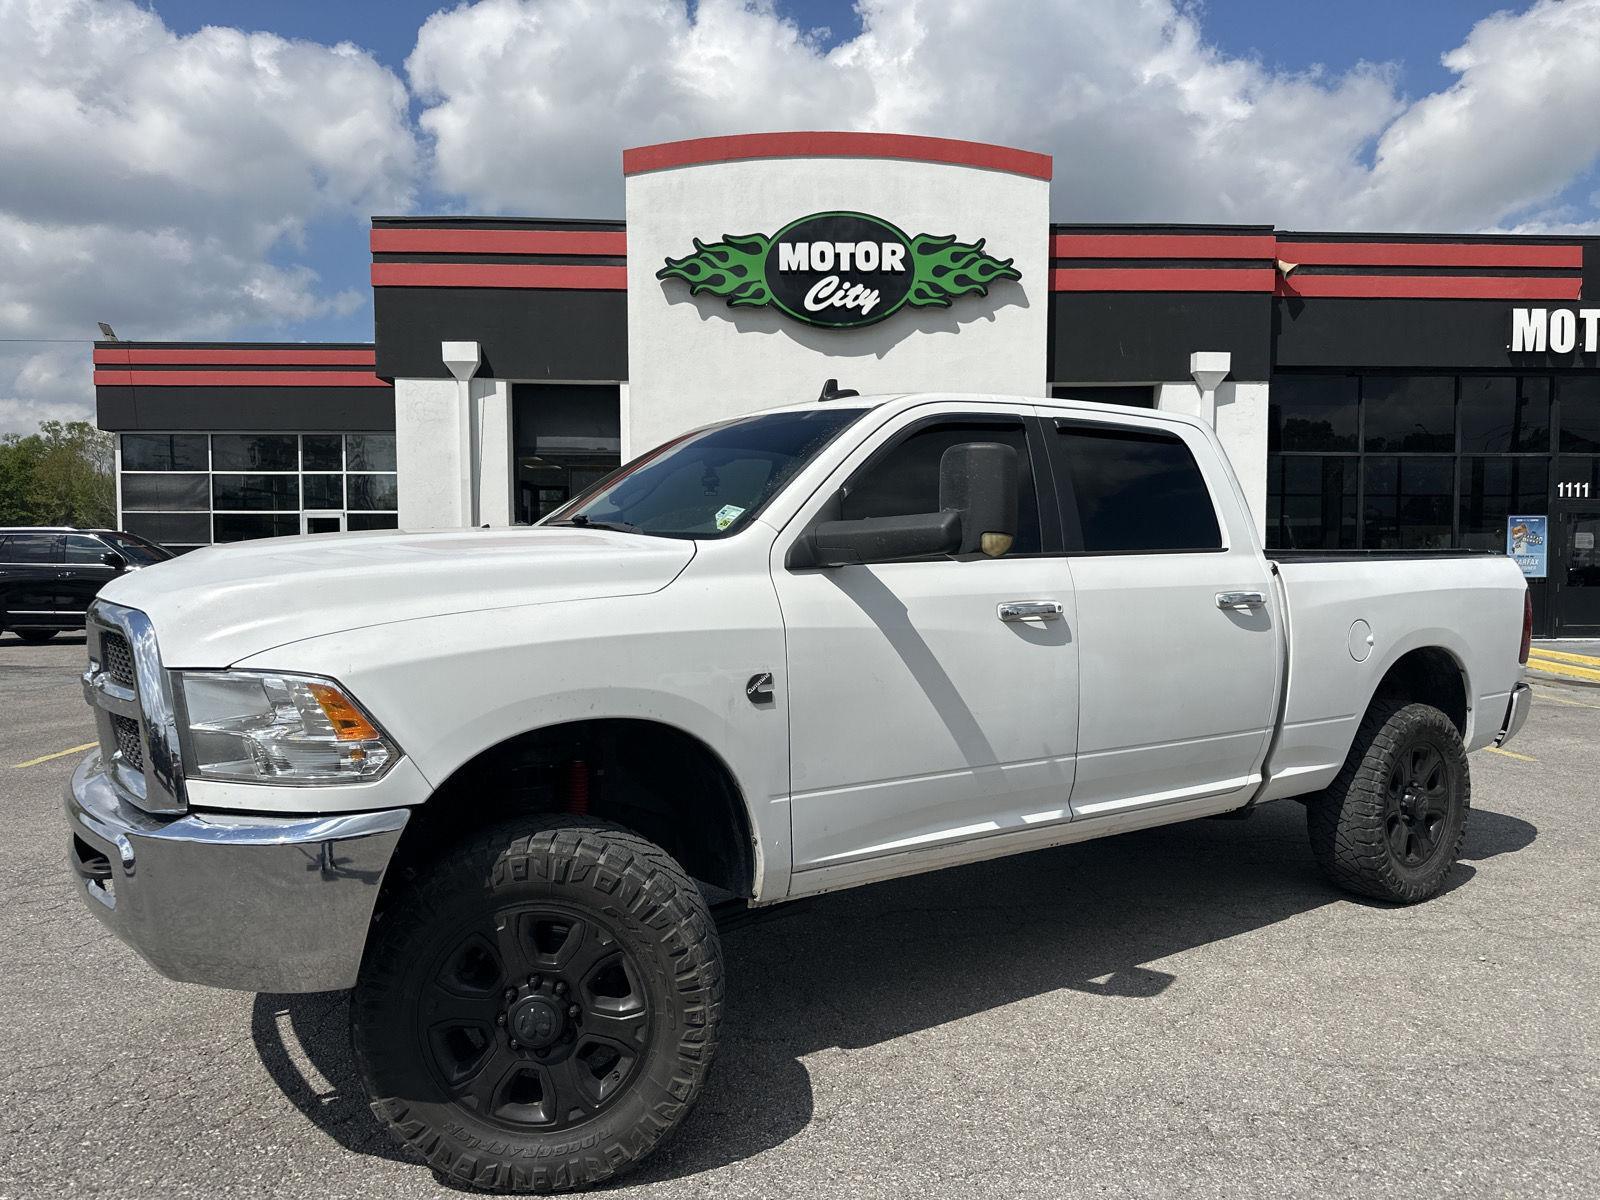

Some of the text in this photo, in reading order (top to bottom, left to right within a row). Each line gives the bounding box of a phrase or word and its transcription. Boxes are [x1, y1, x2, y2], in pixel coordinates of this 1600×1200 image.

[778, 241, 906, 272] MOTOR
[803, 275, 881, 316] City
[1511, 307, 1600, 354] MOT
[1557, 481, 1589, 498] 1111
[747, 672, 770, 694] Cummins
